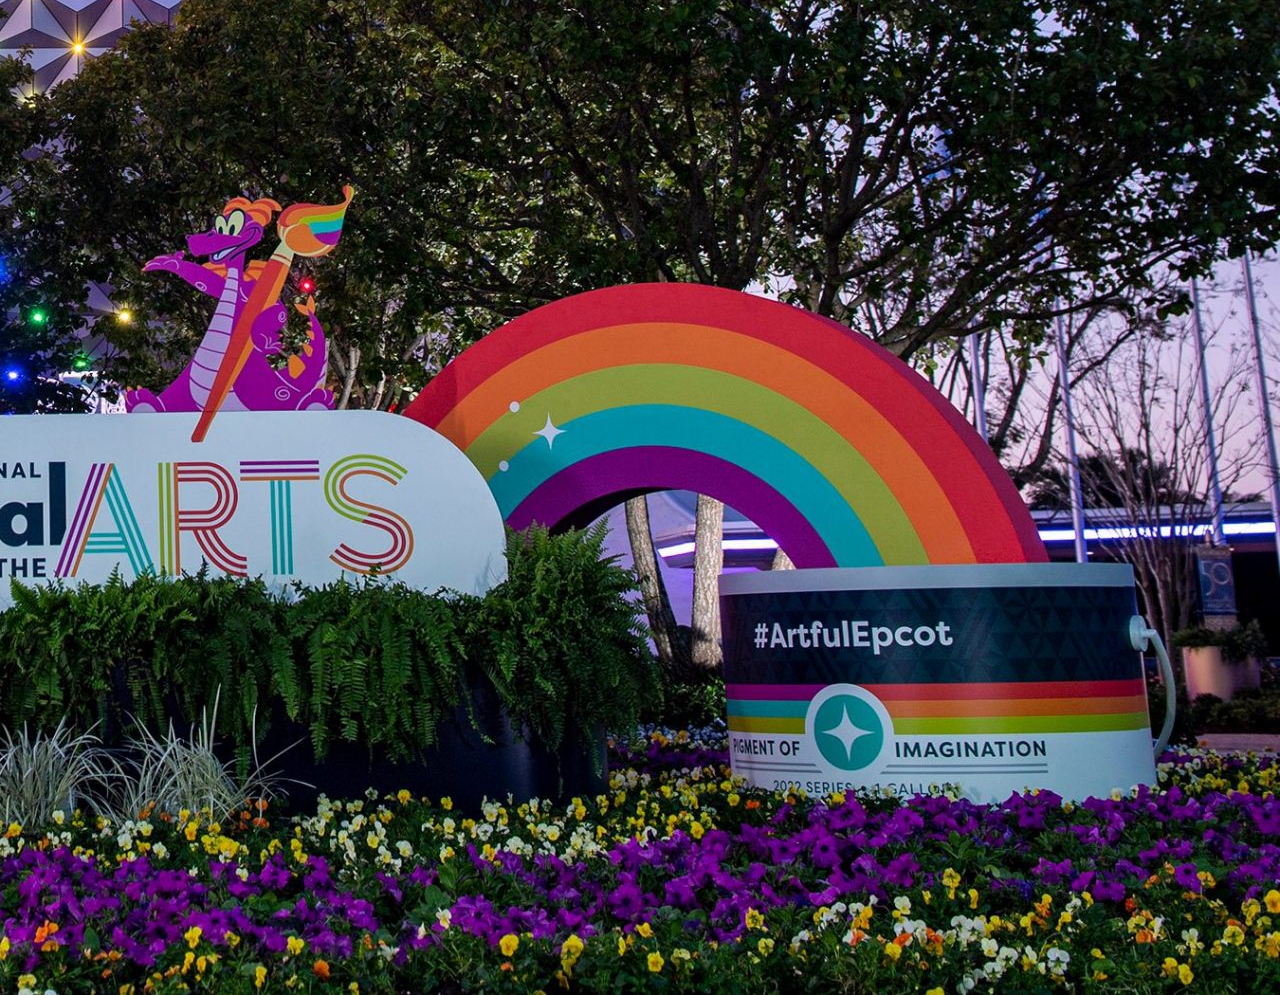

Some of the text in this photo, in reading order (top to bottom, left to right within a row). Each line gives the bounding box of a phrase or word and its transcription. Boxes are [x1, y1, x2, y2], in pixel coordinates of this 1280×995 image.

[55, 454, 415, 578] ARTS
[753, 620, 954, 655] #ArtfulEpcot
[732, 738, 1048, 758] PIGMENT OF IMAGINATION
